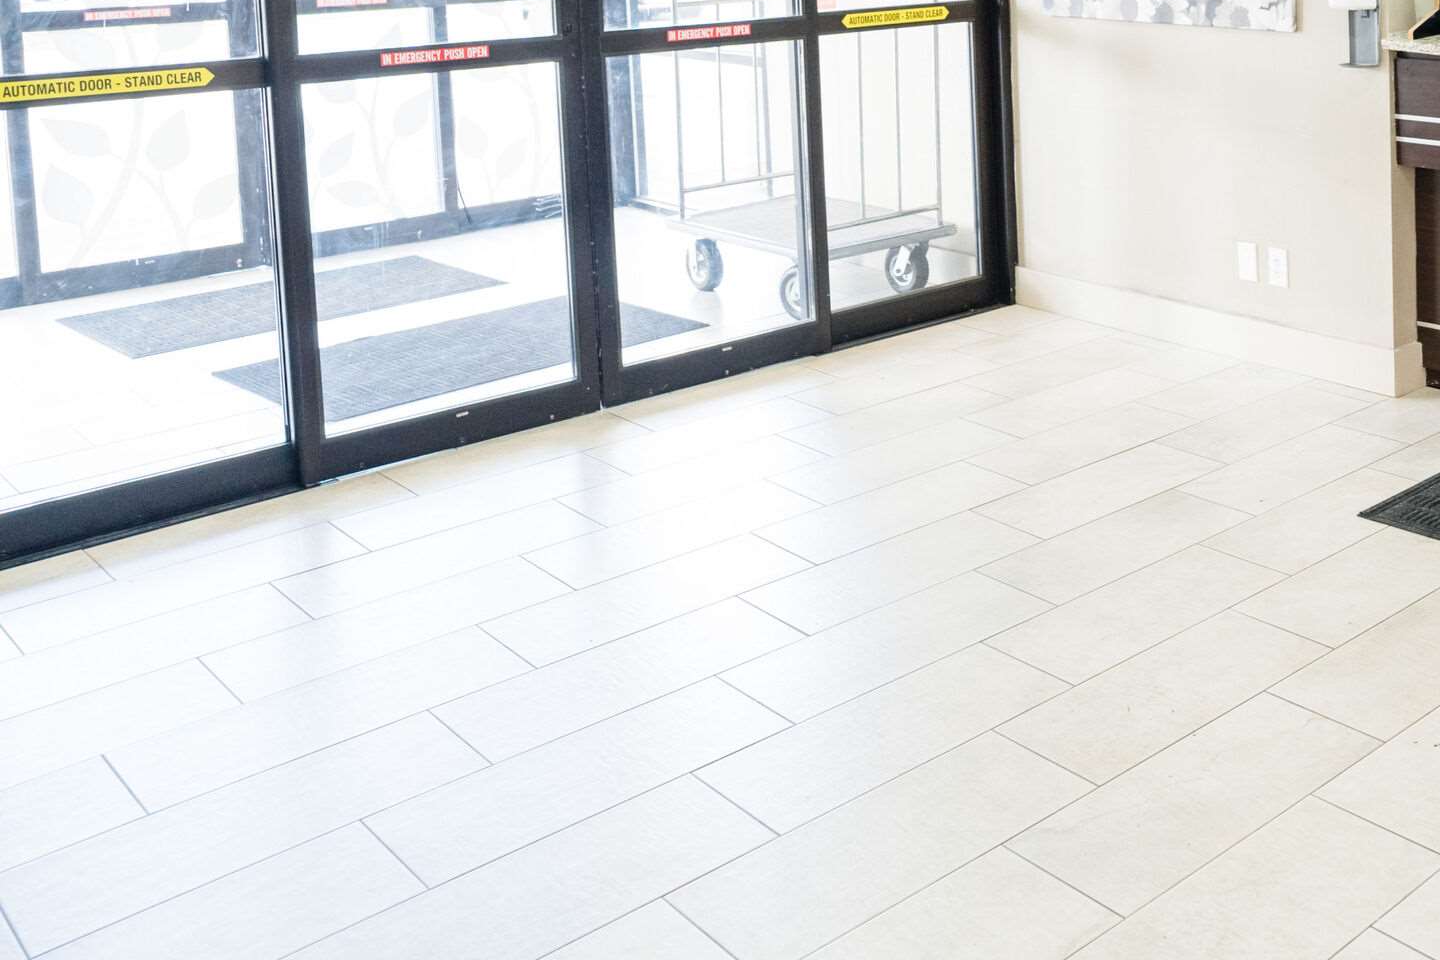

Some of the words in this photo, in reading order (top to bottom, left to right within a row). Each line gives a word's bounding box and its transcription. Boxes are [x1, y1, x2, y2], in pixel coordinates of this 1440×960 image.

[849, 13, 883, 26] AUTOMATIC
[884, 12, 900, 22] DOOR
[905, 9, 924, 20] STAND
[925, 8, 943, 19] CLEAR
[733, 24, 751, 36] OPEN
[382, 52, 392, 66] IN
[394, 49, 441, 65] EMERGENCY
[443, 47, 465, 61] PUSH
[466, 45, 489, 59] OPEN
[2, 80, 76, 98] AUTOMATIC
[79, 78, 112, 93] DOOR
[124, 73, 163, 89] STAND
[167, 71, 202, 85] CLEAR
